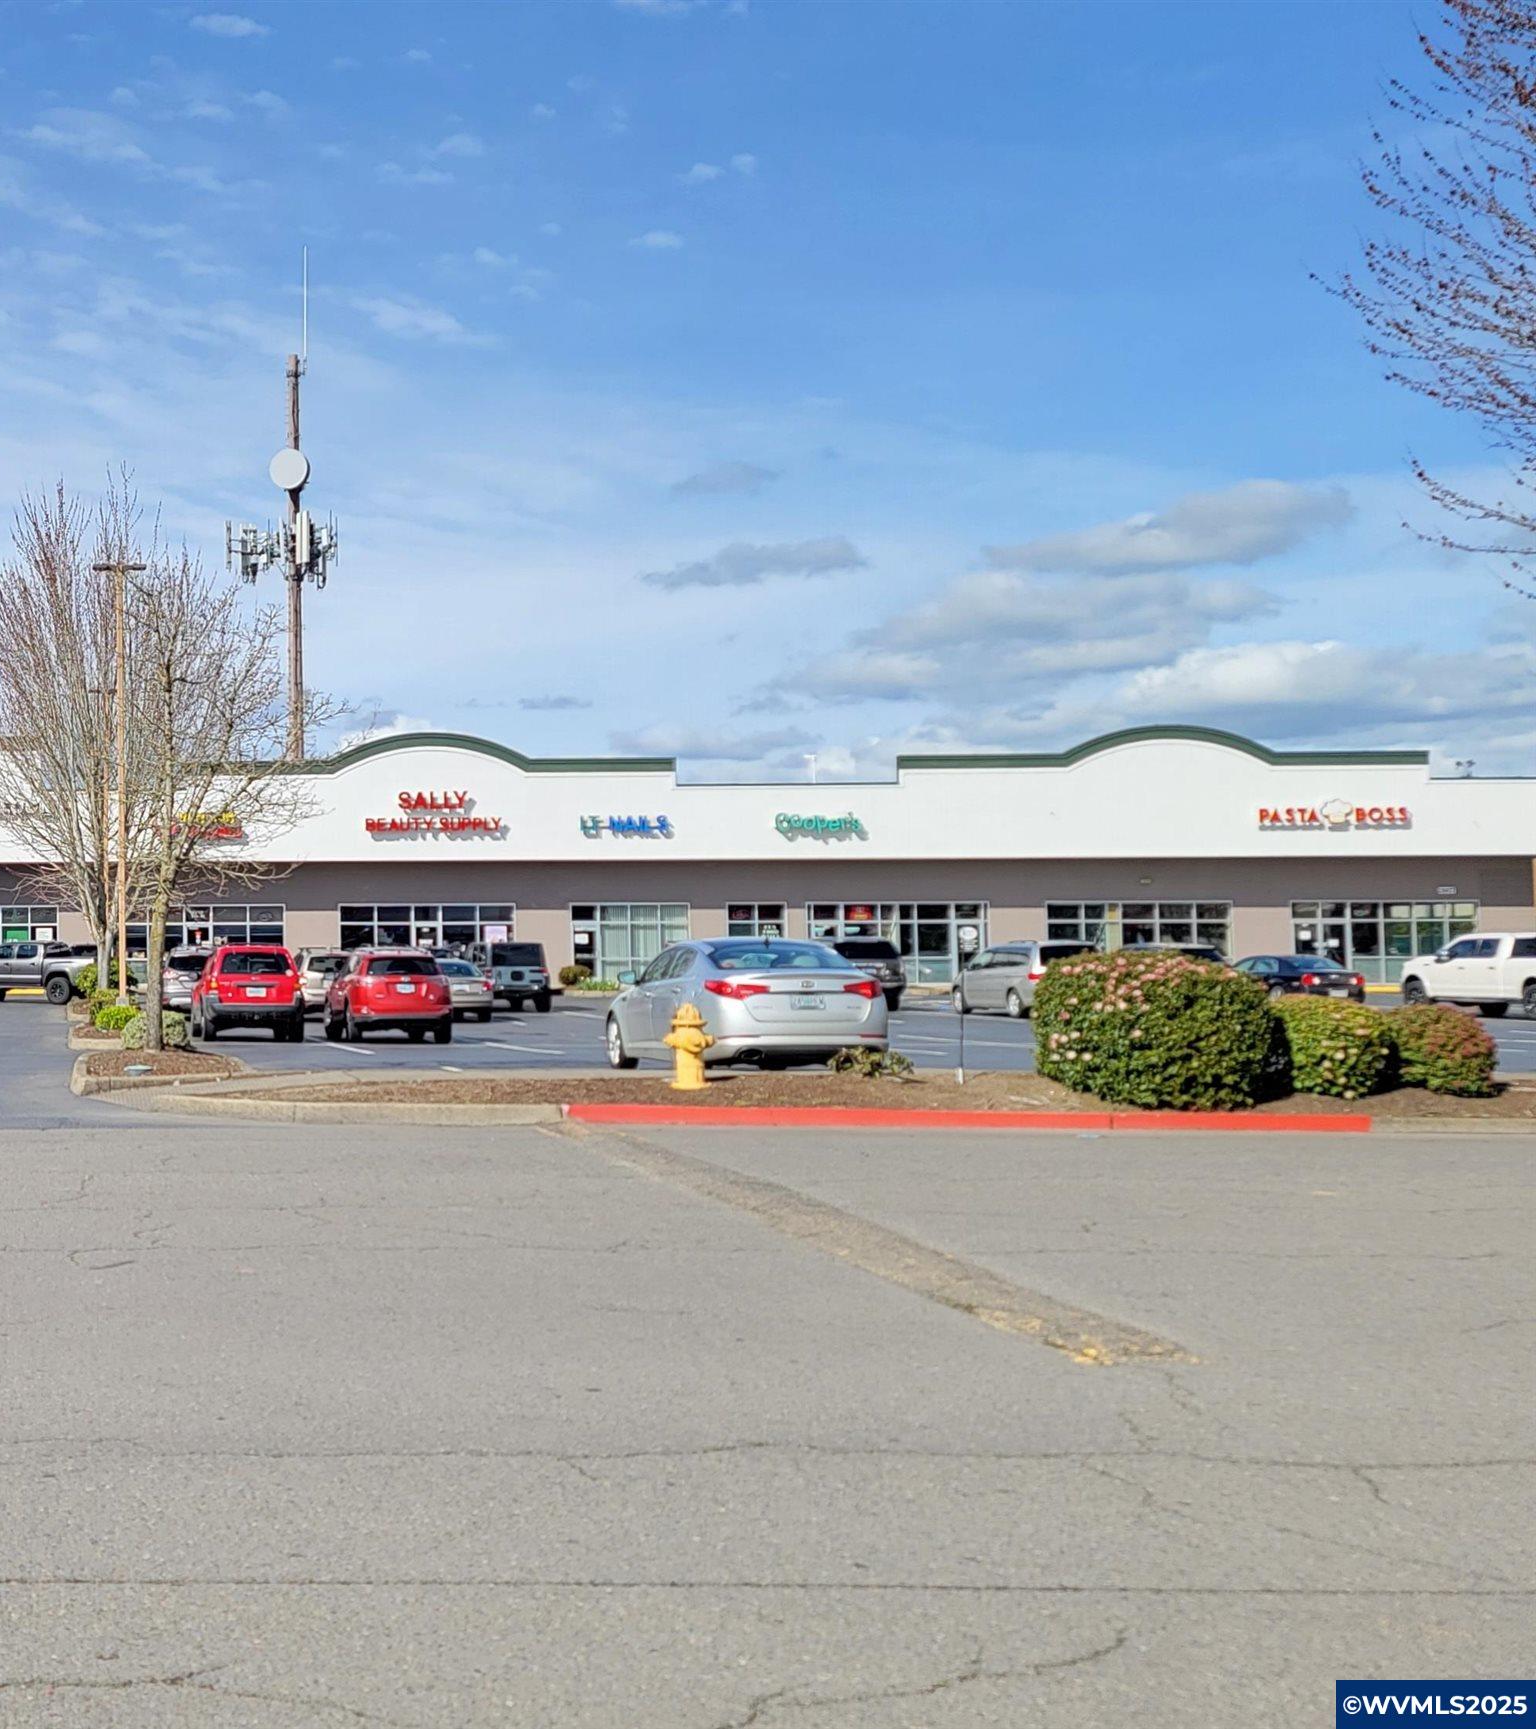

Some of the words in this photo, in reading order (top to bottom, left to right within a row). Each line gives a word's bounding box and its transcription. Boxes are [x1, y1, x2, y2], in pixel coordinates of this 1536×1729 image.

[398, 790, 468, 809] SALLY
[608, 815, 669, 831] NAILS
[1259, 808, 1320, 823] PASTA
[1355, 807, 1408, 823] BOSS
[365, 817, 432, 832] BEAUTY
[439, 817, 502, 832] SUPPLY
